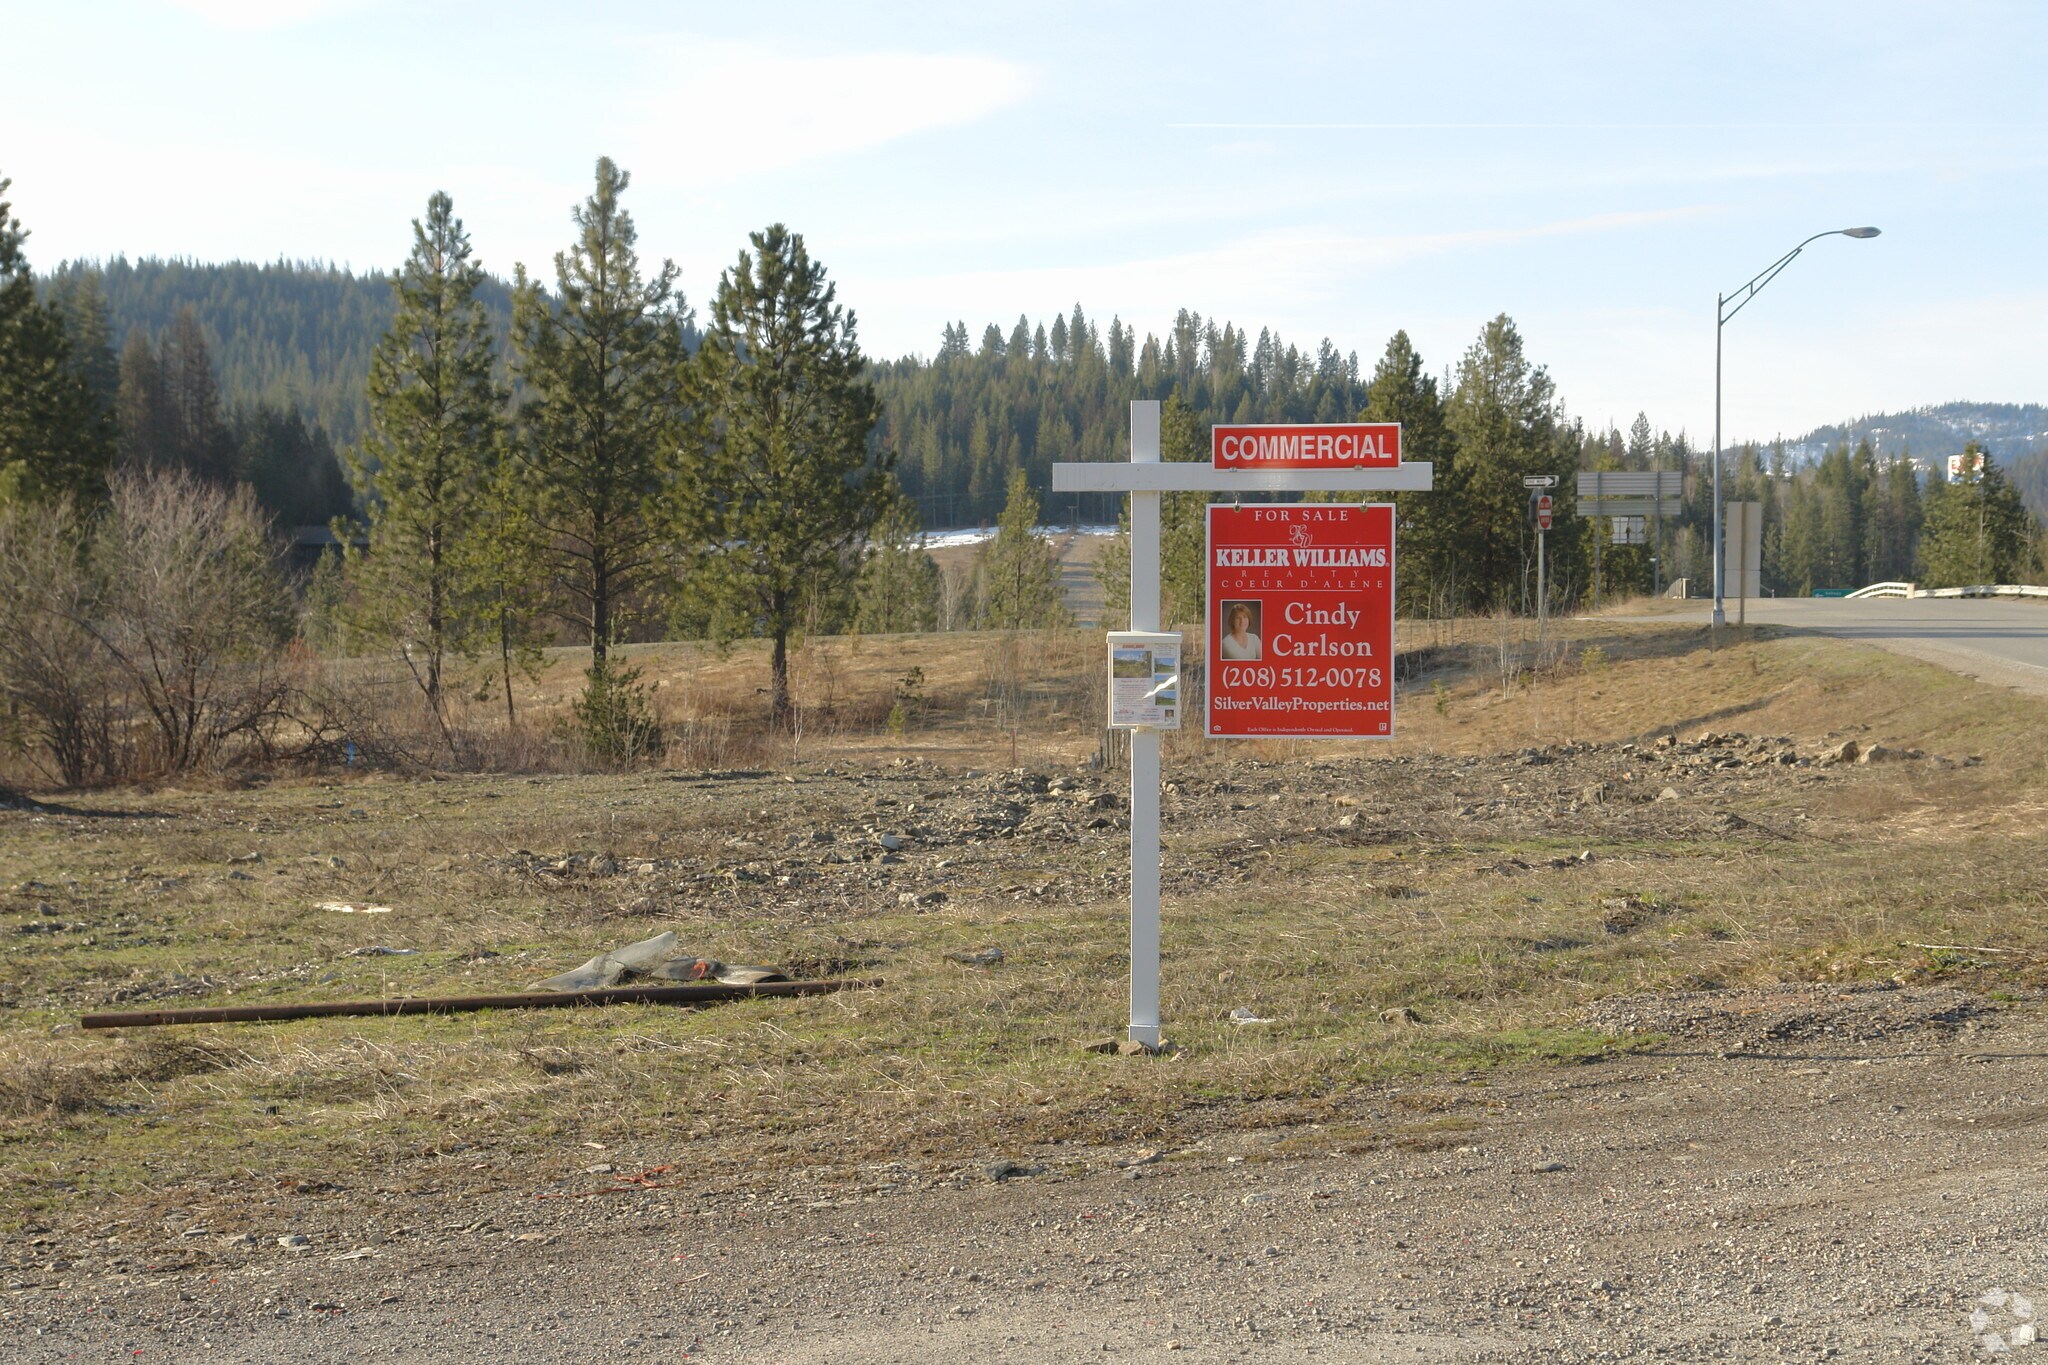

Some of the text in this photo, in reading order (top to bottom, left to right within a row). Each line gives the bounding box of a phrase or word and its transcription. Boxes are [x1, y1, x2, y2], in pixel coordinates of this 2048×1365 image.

[1221, 434, 1392, 461] COMMERCIAL
[1254, 510, 1349, 521] FOR SALE
[1216, 548, 1290, 567] KELLER
[1241, 569, 1360, 578] REALTY
[1221, 580, 1383, 588] COEUR D'ALENE
[1284, 602, 1361, 630] Cindy
[1272, 633, 1373, 657] Carlson
[1222, 666, 1382, 689] (208) 512-0078
[1214, 696, 1390, 713] SilverValleyProperties.net
